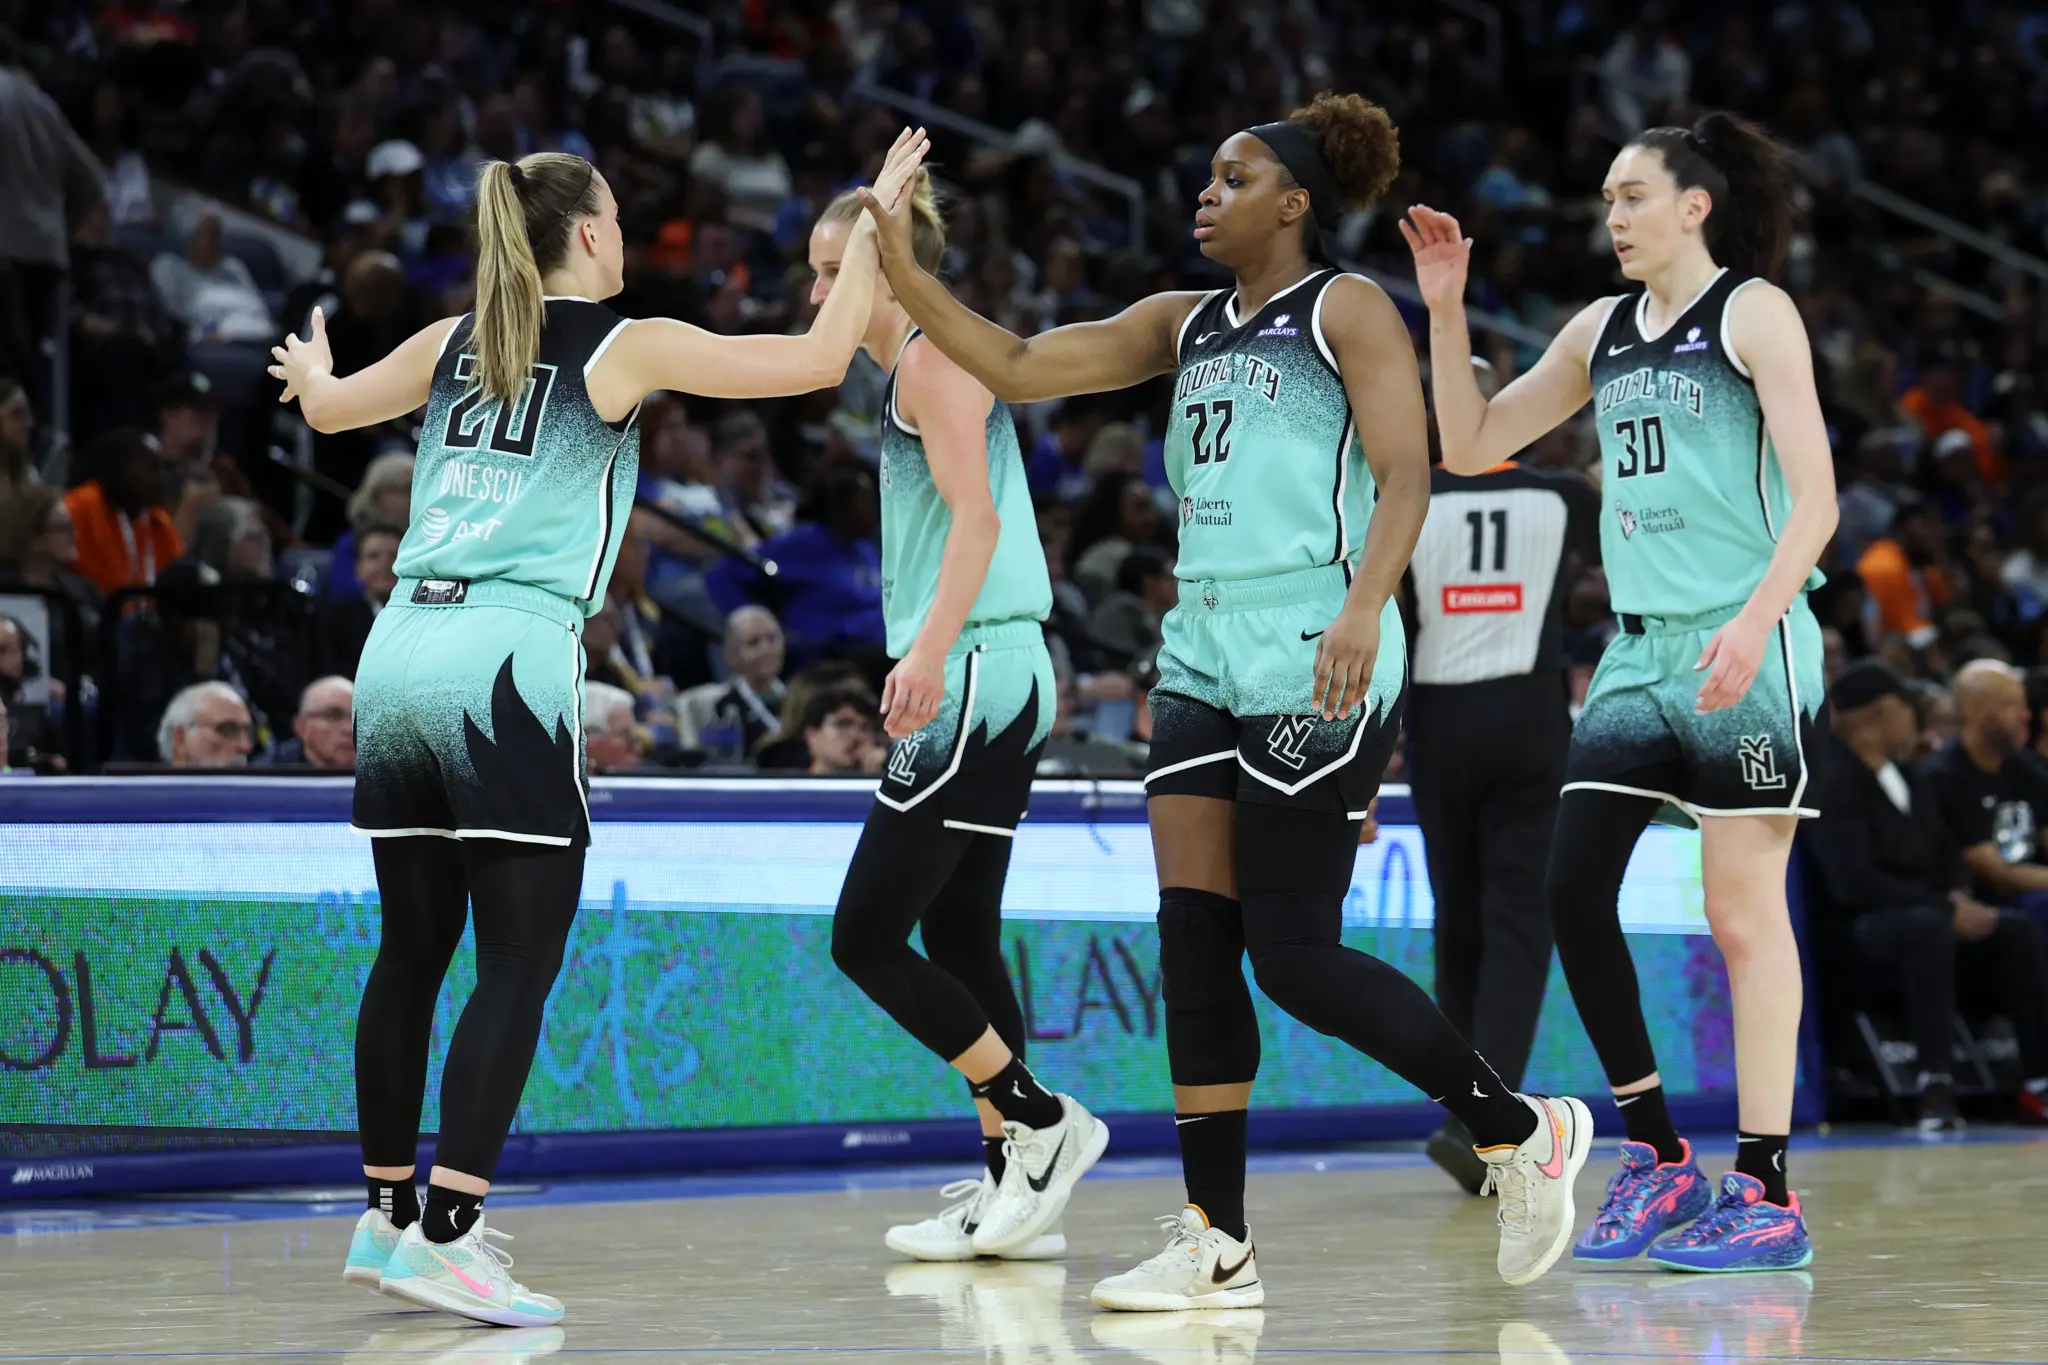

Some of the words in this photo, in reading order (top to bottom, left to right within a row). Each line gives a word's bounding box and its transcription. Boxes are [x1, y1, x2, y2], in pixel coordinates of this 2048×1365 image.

[1257, 327, 1298, 337] BARCLAYS
[444, 354, 559, 459] 20
[1185, 399, 1234, 466] 22
[1614, 414, 1667, 481] 30
[1466, 510, 1507, 572] 11
[0, 946, 276, 1070] OLAY
[1003, 932, 1161, 1043] LAY
[34, 1164, 94, 1181] MAGELLAN
